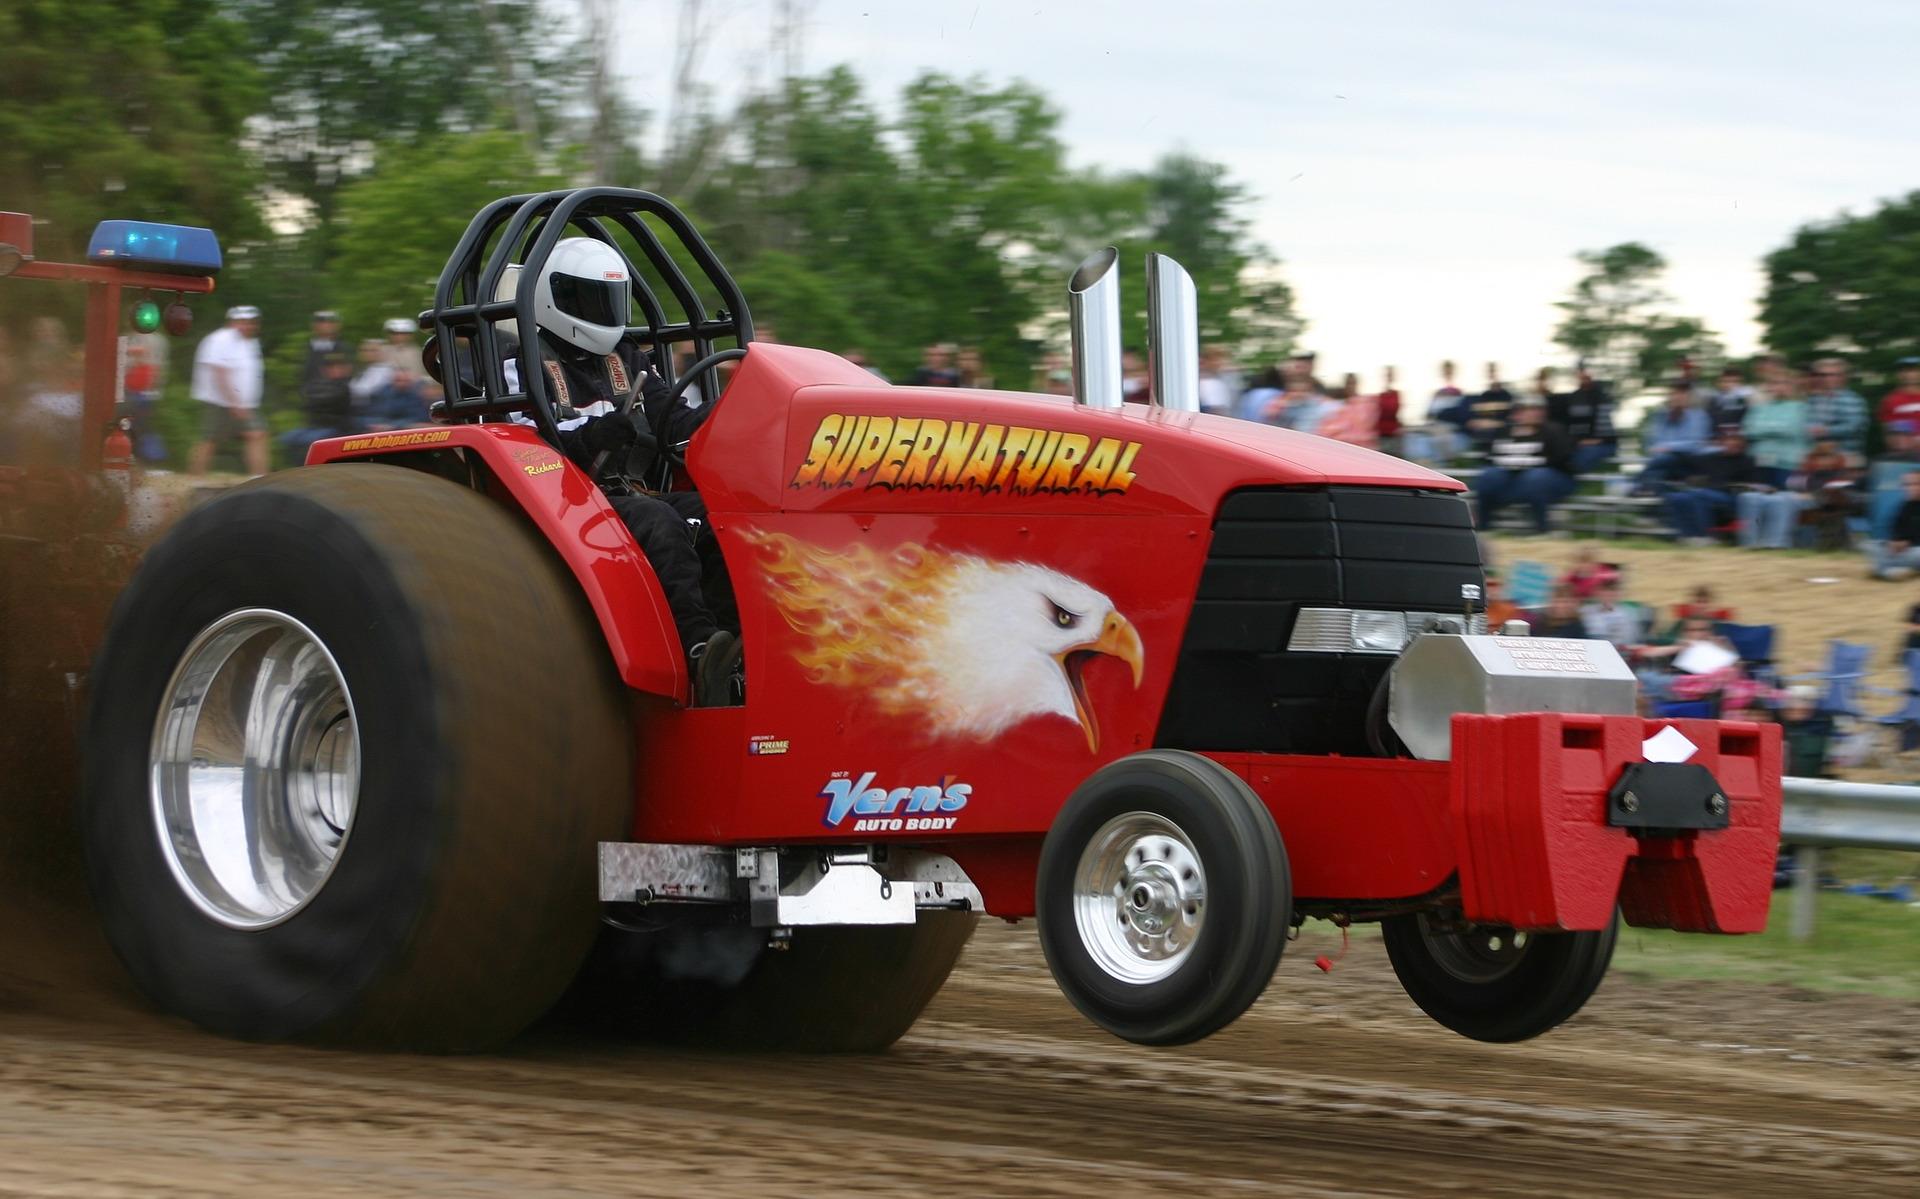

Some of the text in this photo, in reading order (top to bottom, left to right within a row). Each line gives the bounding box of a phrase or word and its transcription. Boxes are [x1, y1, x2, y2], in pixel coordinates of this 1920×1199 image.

[342, 430, 451, 451] www.hphparts.com
[789, 414, 1143, 497] SUPERNATURAL
[523, 459, 564, 477] Richard
[818, 771, 973, 828] Vern's
[853, 817, 957, 832] AUTO BODY
